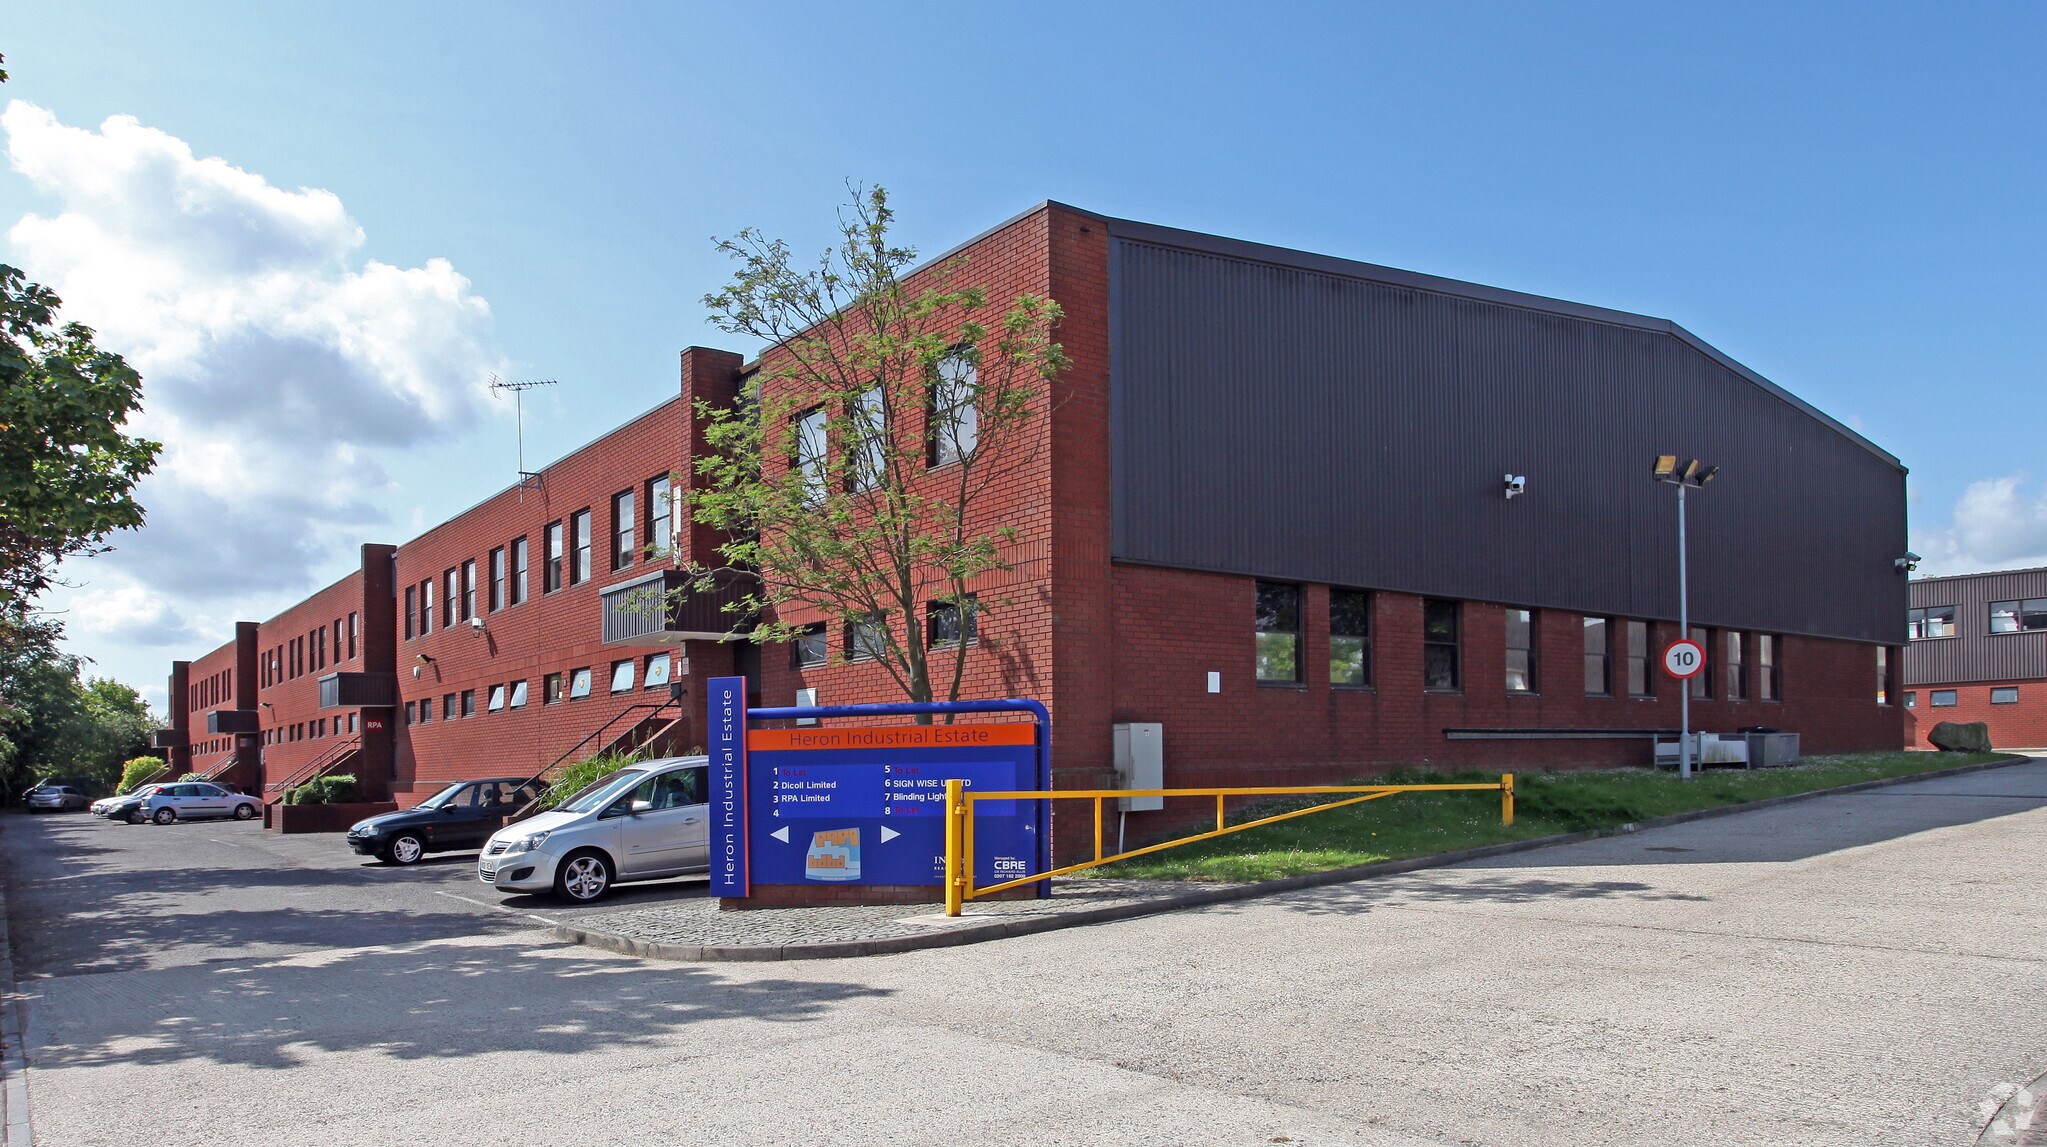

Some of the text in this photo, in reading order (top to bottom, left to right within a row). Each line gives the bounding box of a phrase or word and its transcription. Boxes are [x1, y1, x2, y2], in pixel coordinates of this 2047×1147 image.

[1673, 651, 1694, 667] 10
[367, 721, 383, 729] RPA
[790, 728, 989, 746] Heron Industrial Estate
[773, 767, 778, 776] 1
[884, 765, 891, 773] 5
[722, 689, 734, 885] Heron Industrial Estate
[773, 780, 837, 790] 2 Dicoll Limited
[884, 779, 891, 787] 6
[893, 780, 914, 788] SIGN
[916, 779, 938, 787] WISE
[773, 793, 831, 804] 3 RPA Limited
[884, 792, 891, 801] 7
[893, 792, 925, 803] Blinding
[773, 809, 780, 818] 4
[884, 806, 891, 815] 8
[994, 861, 1026, 870] CBRE
